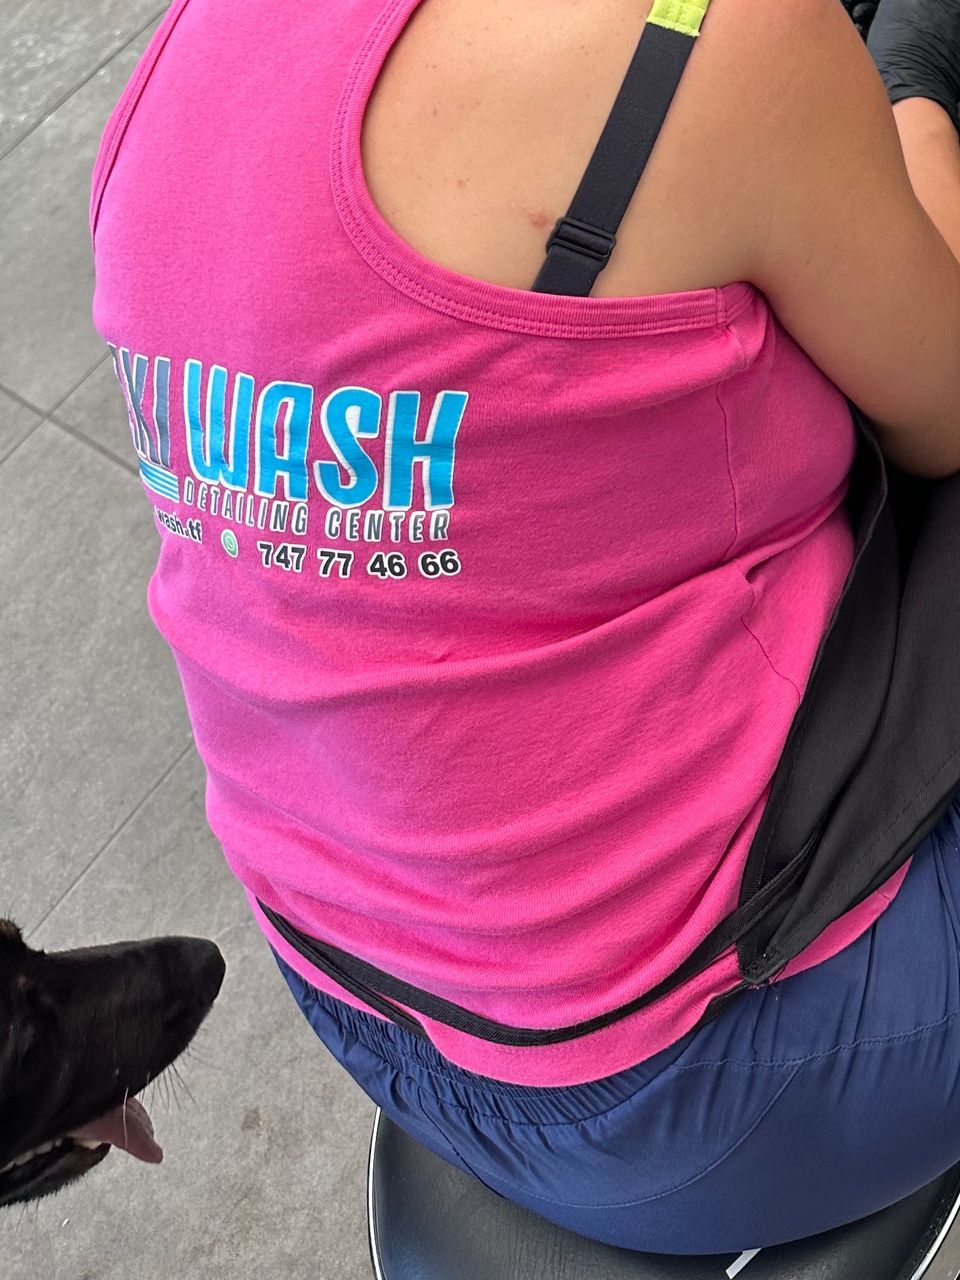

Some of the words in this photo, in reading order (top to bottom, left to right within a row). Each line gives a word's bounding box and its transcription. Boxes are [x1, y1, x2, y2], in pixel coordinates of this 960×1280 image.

[184, 359, 469, 510] WASH
[184, 476, 308, 535] DETAILING
[325, 507, 450, 542] CENTER
[257, 541, 307, 572] 747
[317, 548, 354, 578] 77
[367, 551, 407, 579] 46
[418, 549, 461, 578] 66
